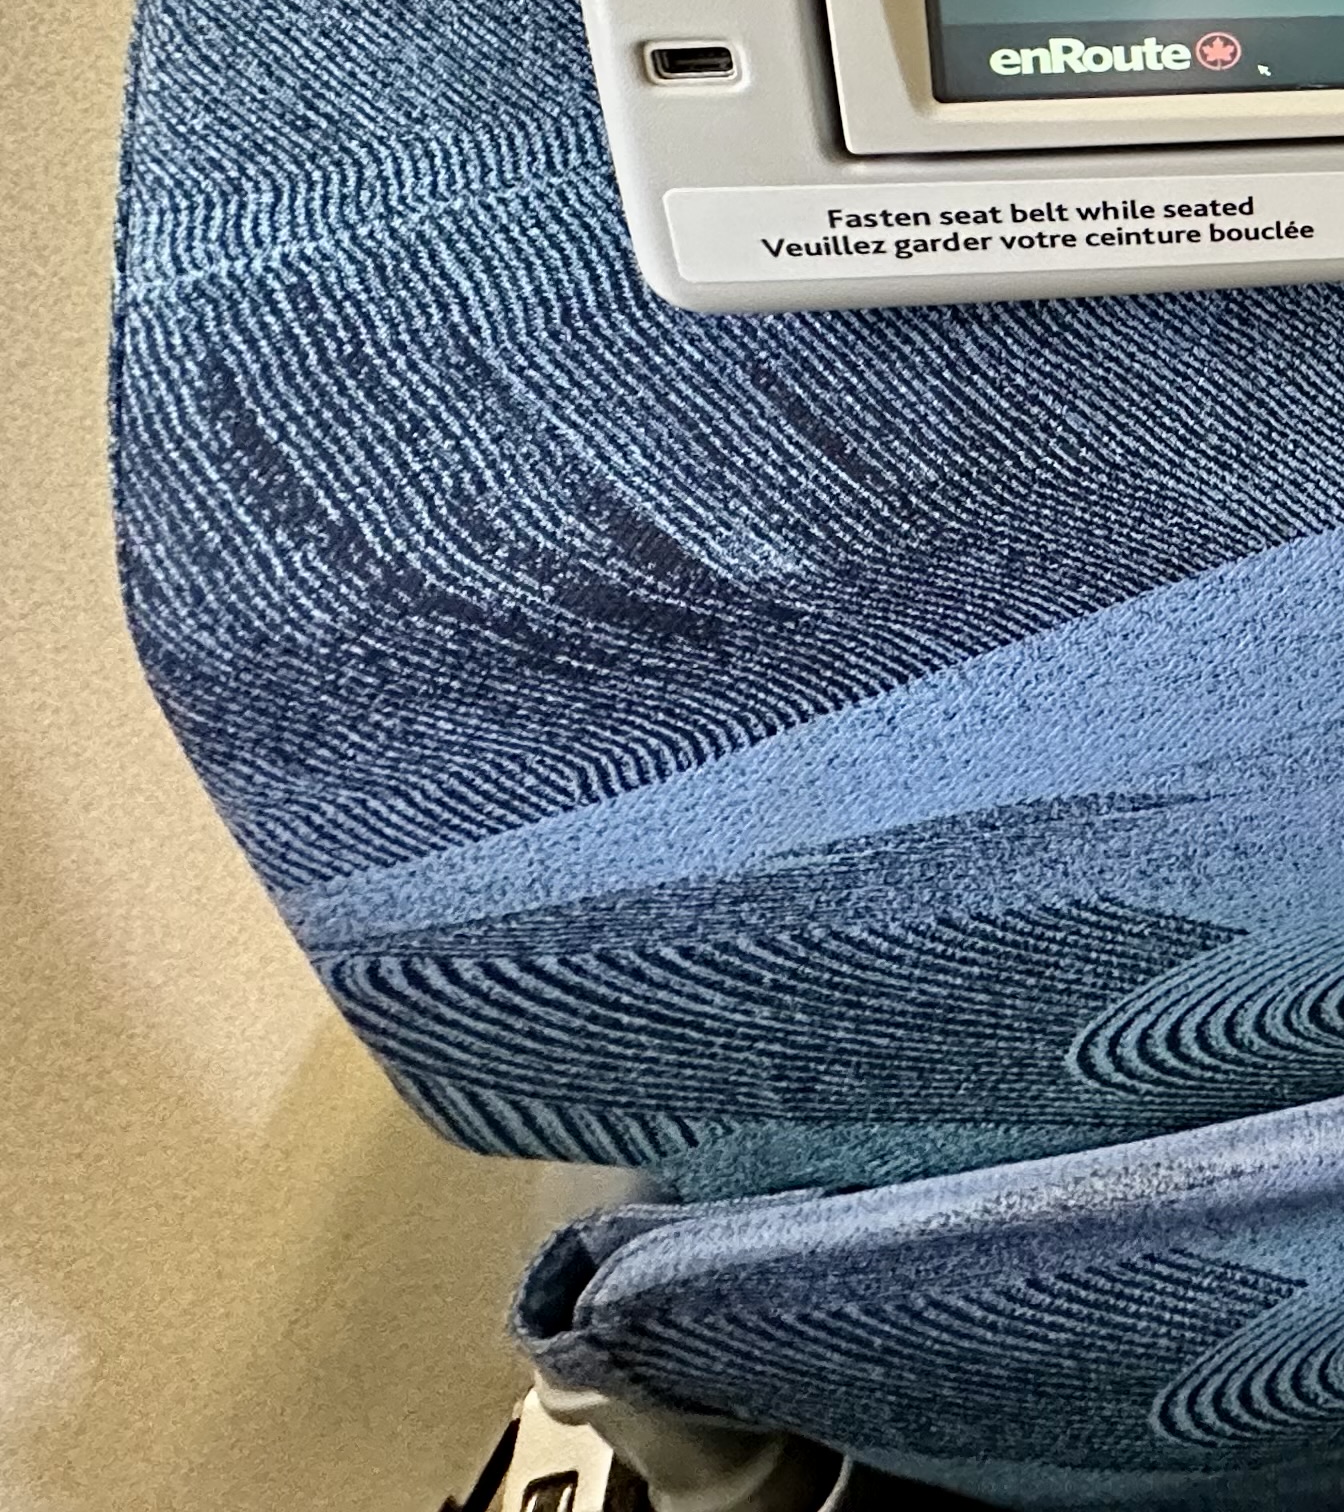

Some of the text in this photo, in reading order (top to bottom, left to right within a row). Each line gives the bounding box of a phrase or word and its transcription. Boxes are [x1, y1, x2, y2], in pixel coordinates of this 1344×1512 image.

[989, 37, 1192, 75] enRoute
[827, 196, 1254, 229] Fasten seat belt while seated
[761, 219, 1315, 261] Veuillez garder votre ceinture bouclée
